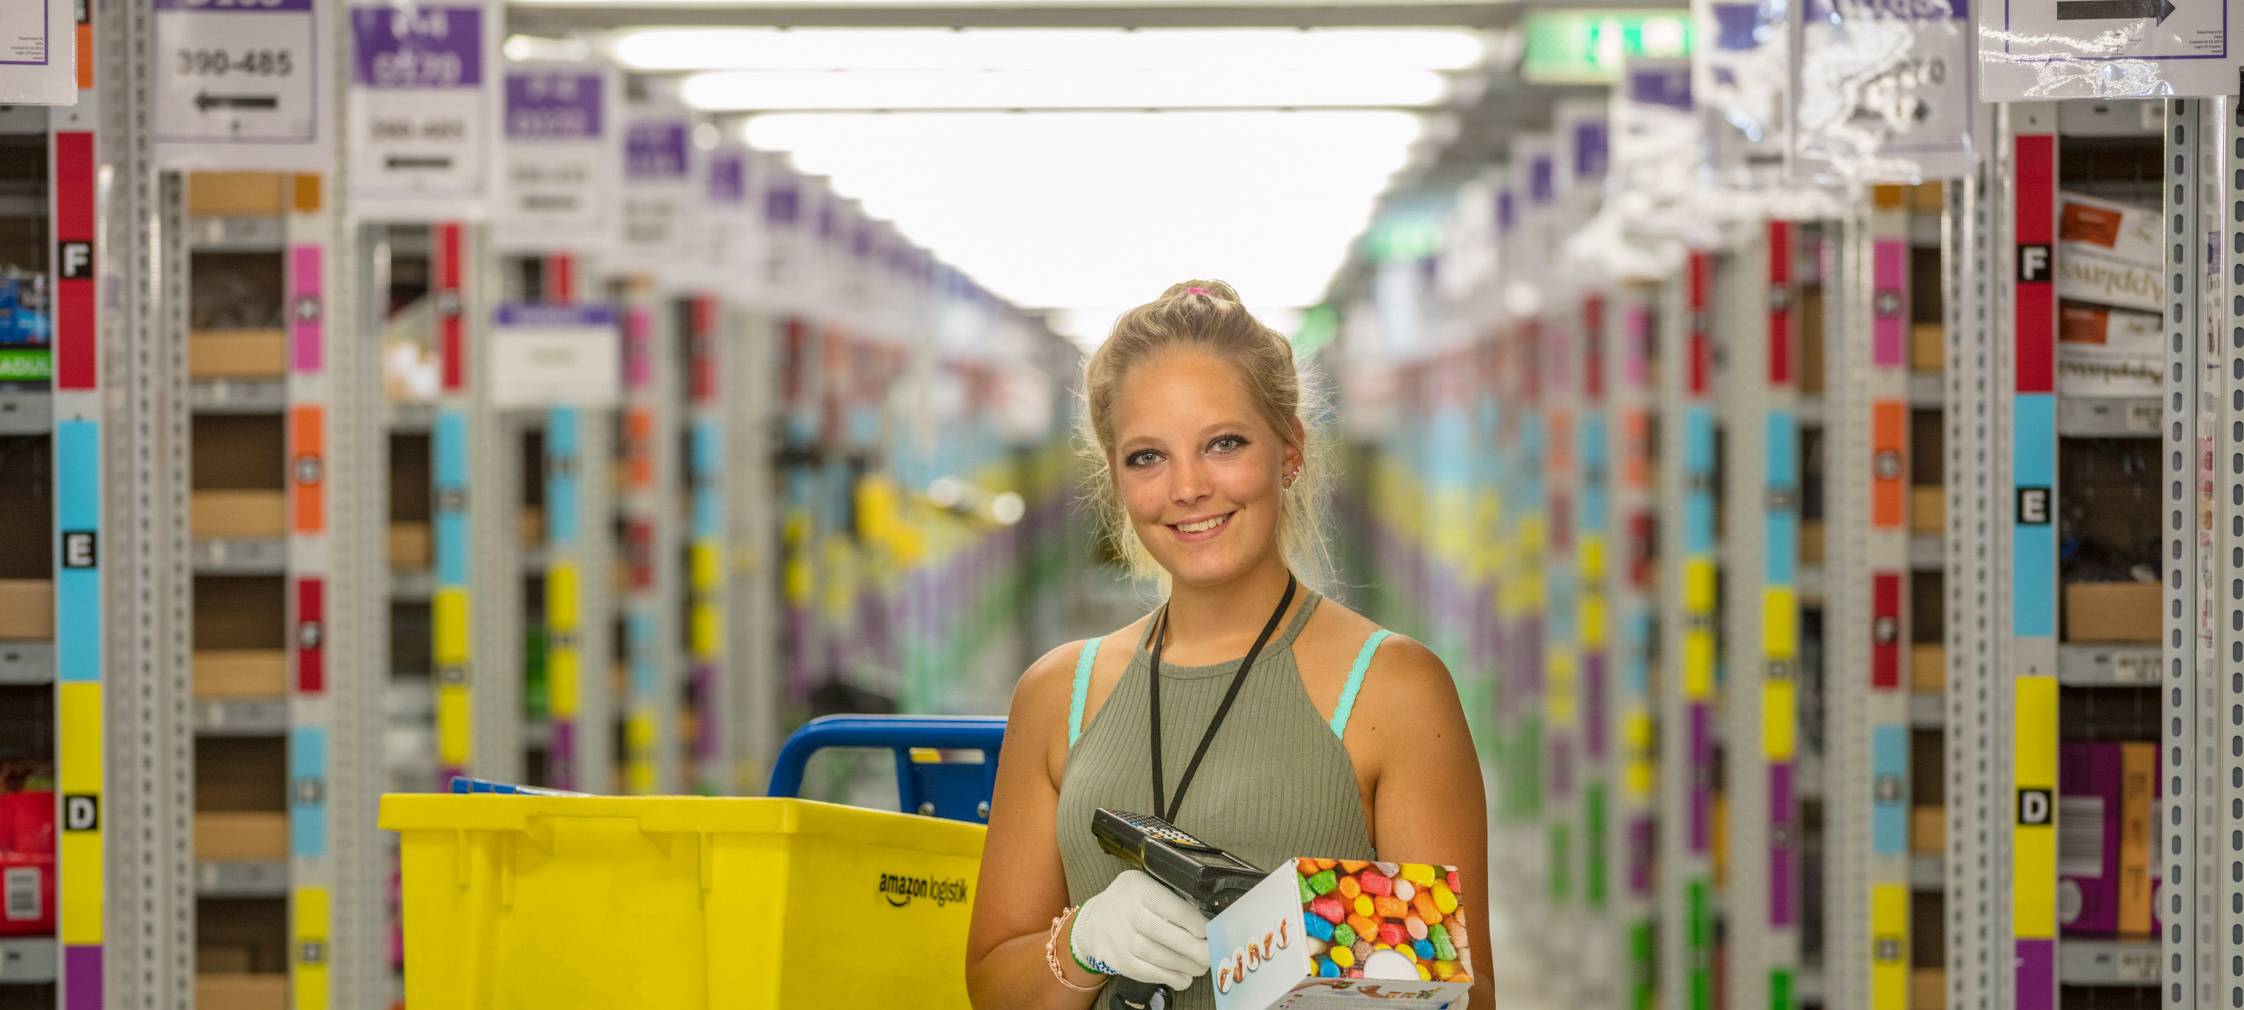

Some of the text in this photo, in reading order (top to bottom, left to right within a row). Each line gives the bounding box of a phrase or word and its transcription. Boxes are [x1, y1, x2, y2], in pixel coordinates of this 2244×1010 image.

[177, 49, 293, 76] 390-485
[64, 244, 89, 277] F
[2022, 247, 2048, 280] F
[2022, 490, 2046, 522] E
[67, 534, 92, 566] E
[68, 797, 96, 829] D
[2022, 792, 2049, 823] D
[879, 872, 968, 908] amazon logistik
